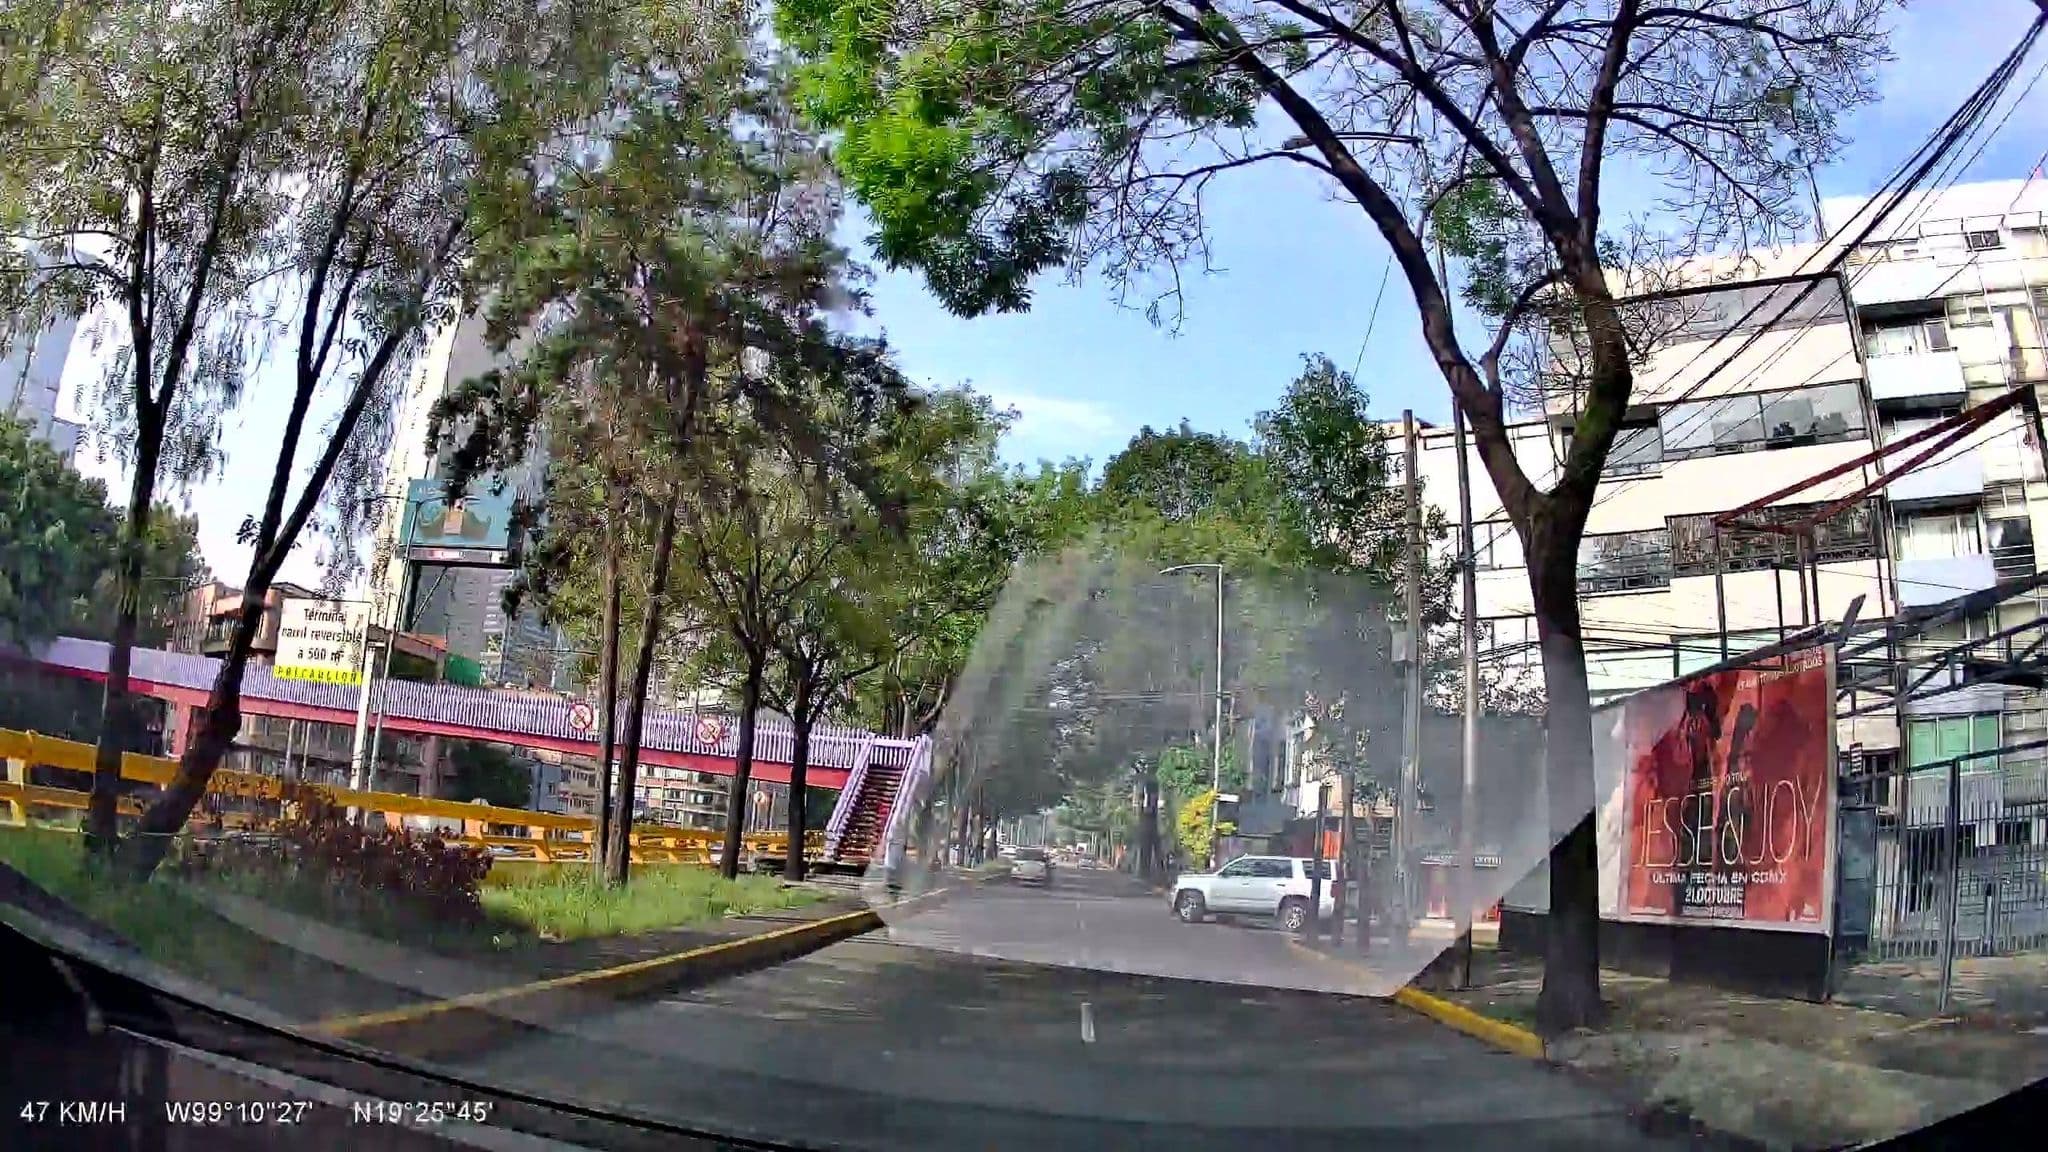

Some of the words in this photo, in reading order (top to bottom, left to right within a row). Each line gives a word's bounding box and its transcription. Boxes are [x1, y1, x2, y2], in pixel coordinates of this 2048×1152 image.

[311, 627, 362, 642] reversible
[1632, 791, 1713, 867] JESSE
[1750, 774, 1823, 865] JOY
